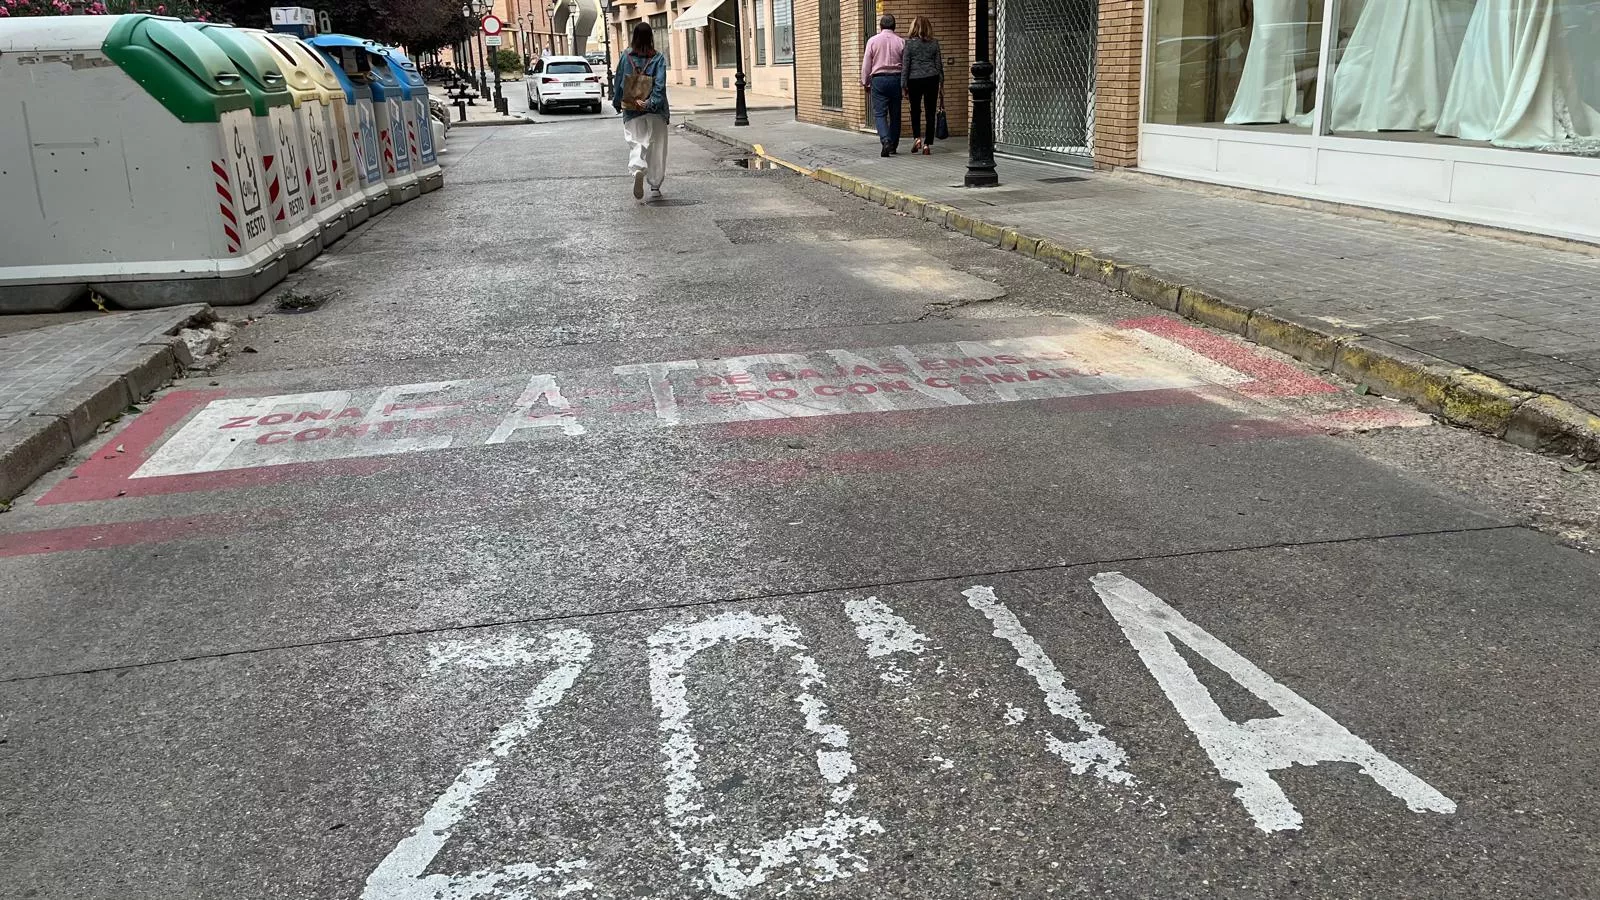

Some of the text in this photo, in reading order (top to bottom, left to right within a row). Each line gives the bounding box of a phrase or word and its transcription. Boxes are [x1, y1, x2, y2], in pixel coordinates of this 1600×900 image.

[288, 196, 304, 217] RESTO
[245, 214, 266, 240] RESTO
[813, 380, 913, 397] CON
[218, 407, 363, 430] ZONA
